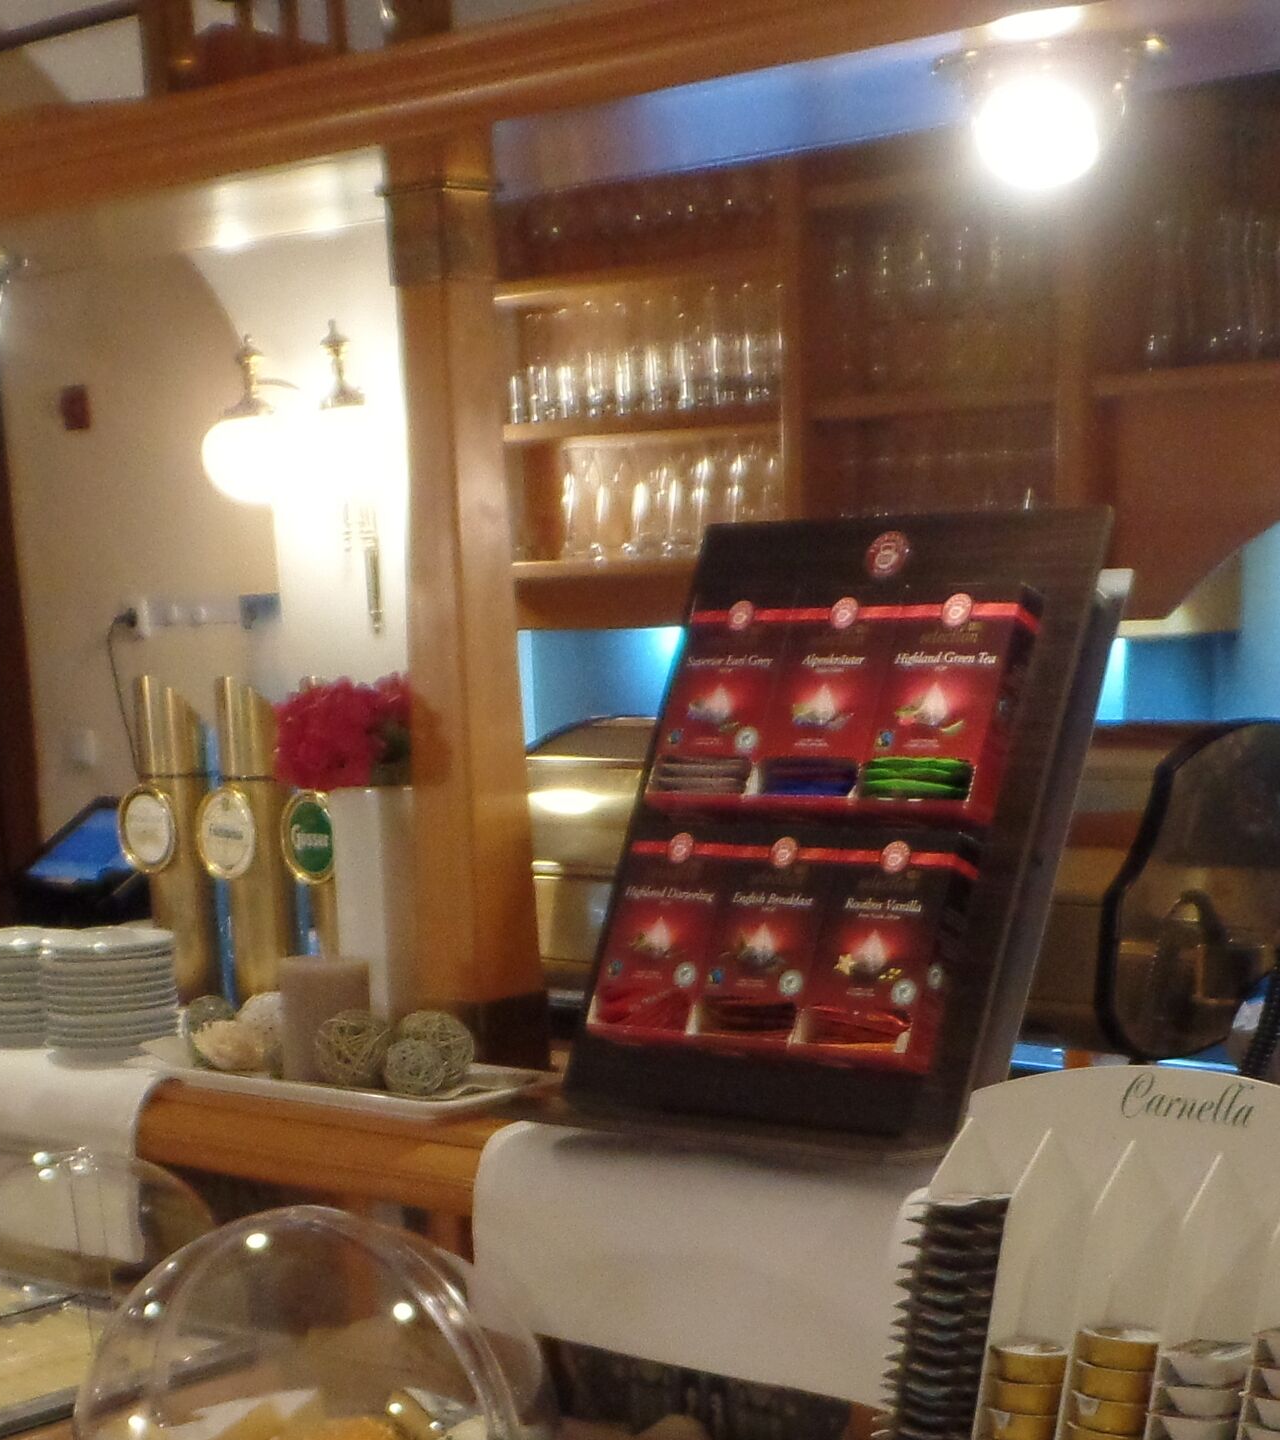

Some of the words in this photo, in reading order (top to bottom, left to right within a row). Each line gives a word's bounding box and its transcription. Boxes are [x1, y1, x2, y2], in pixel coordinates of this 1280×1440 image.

[894, 652, 941, 669] Highland
[944, 652, 975, 664] Green
[977, 652, 998, 665] Tea
